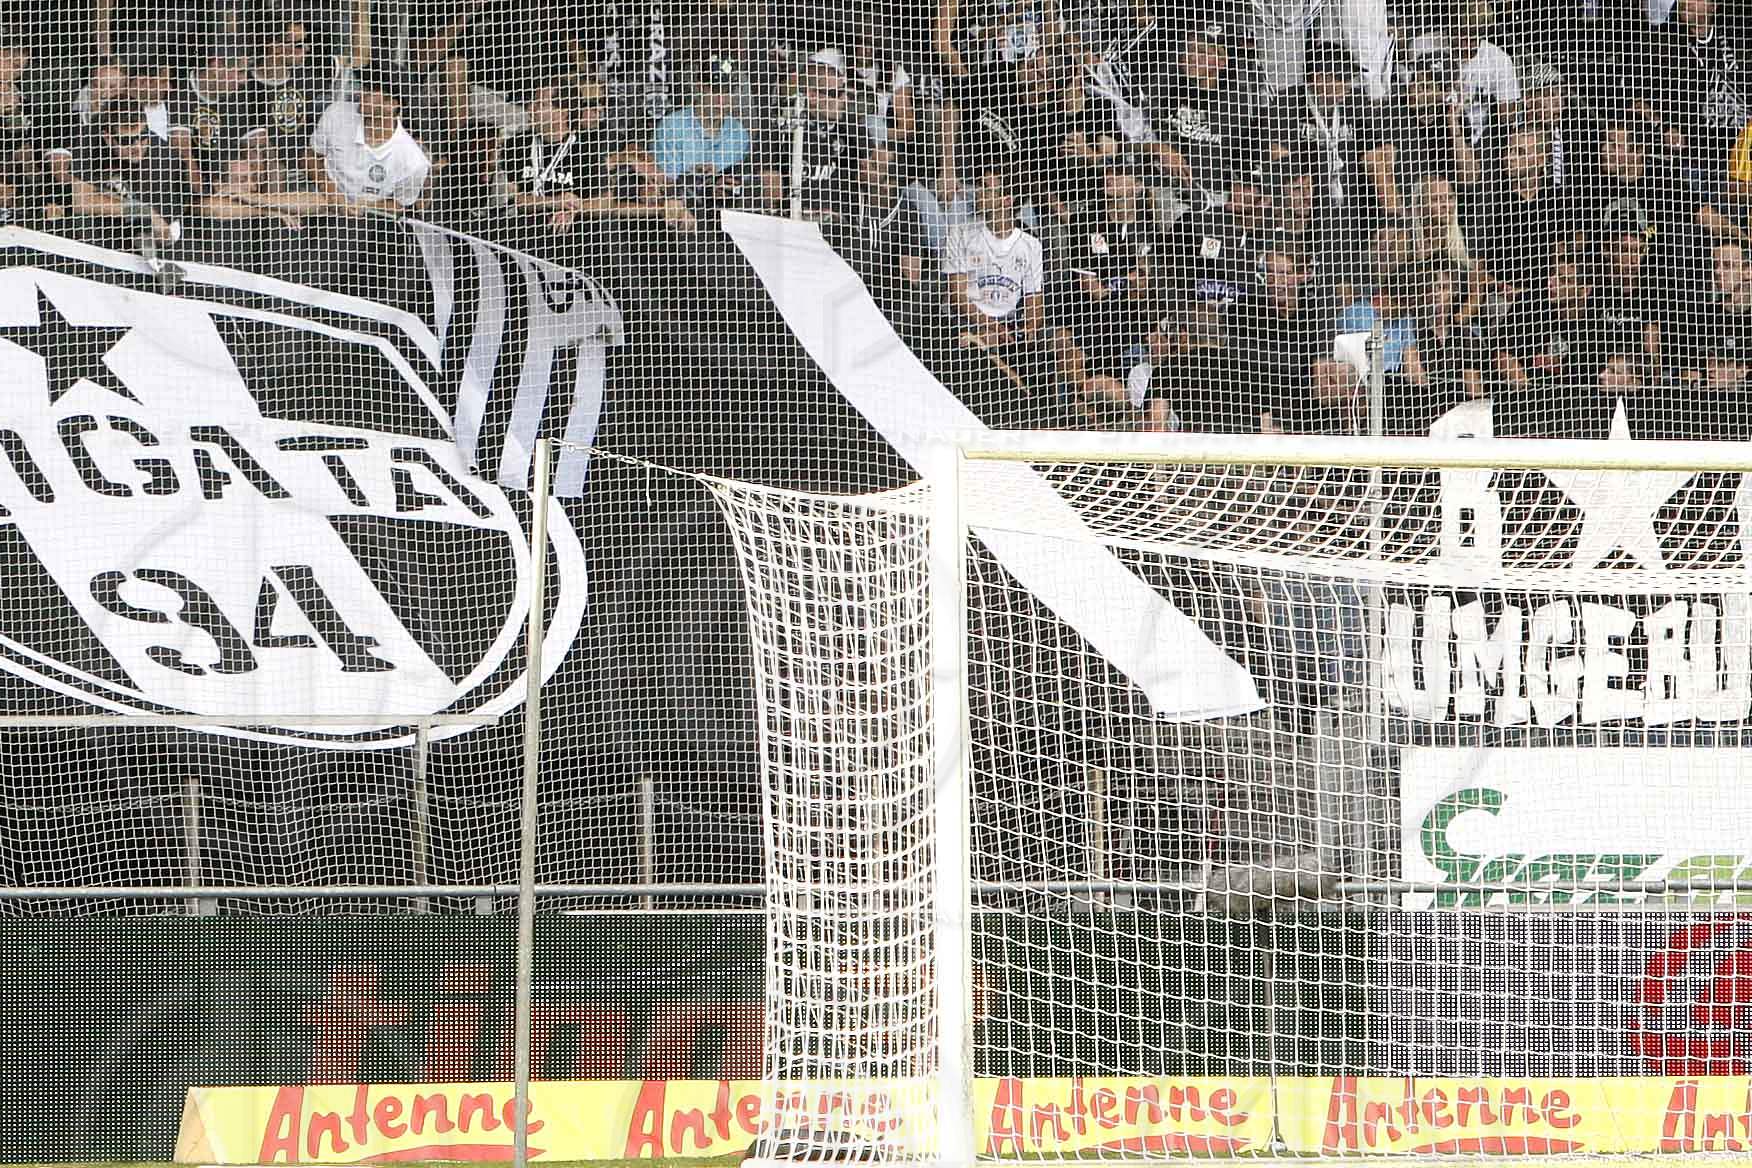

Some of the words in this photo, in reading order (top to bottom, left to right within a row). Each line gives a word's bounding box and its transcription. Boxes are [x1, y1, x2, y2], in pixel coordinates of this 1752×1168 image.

[89, 564, 401, 674] 94
[258, 1086, 546, 1164] Antenne
[988, 1078, 1250, 1158] Antenne
[1322, 1078, 1582, 1158] Antenne
